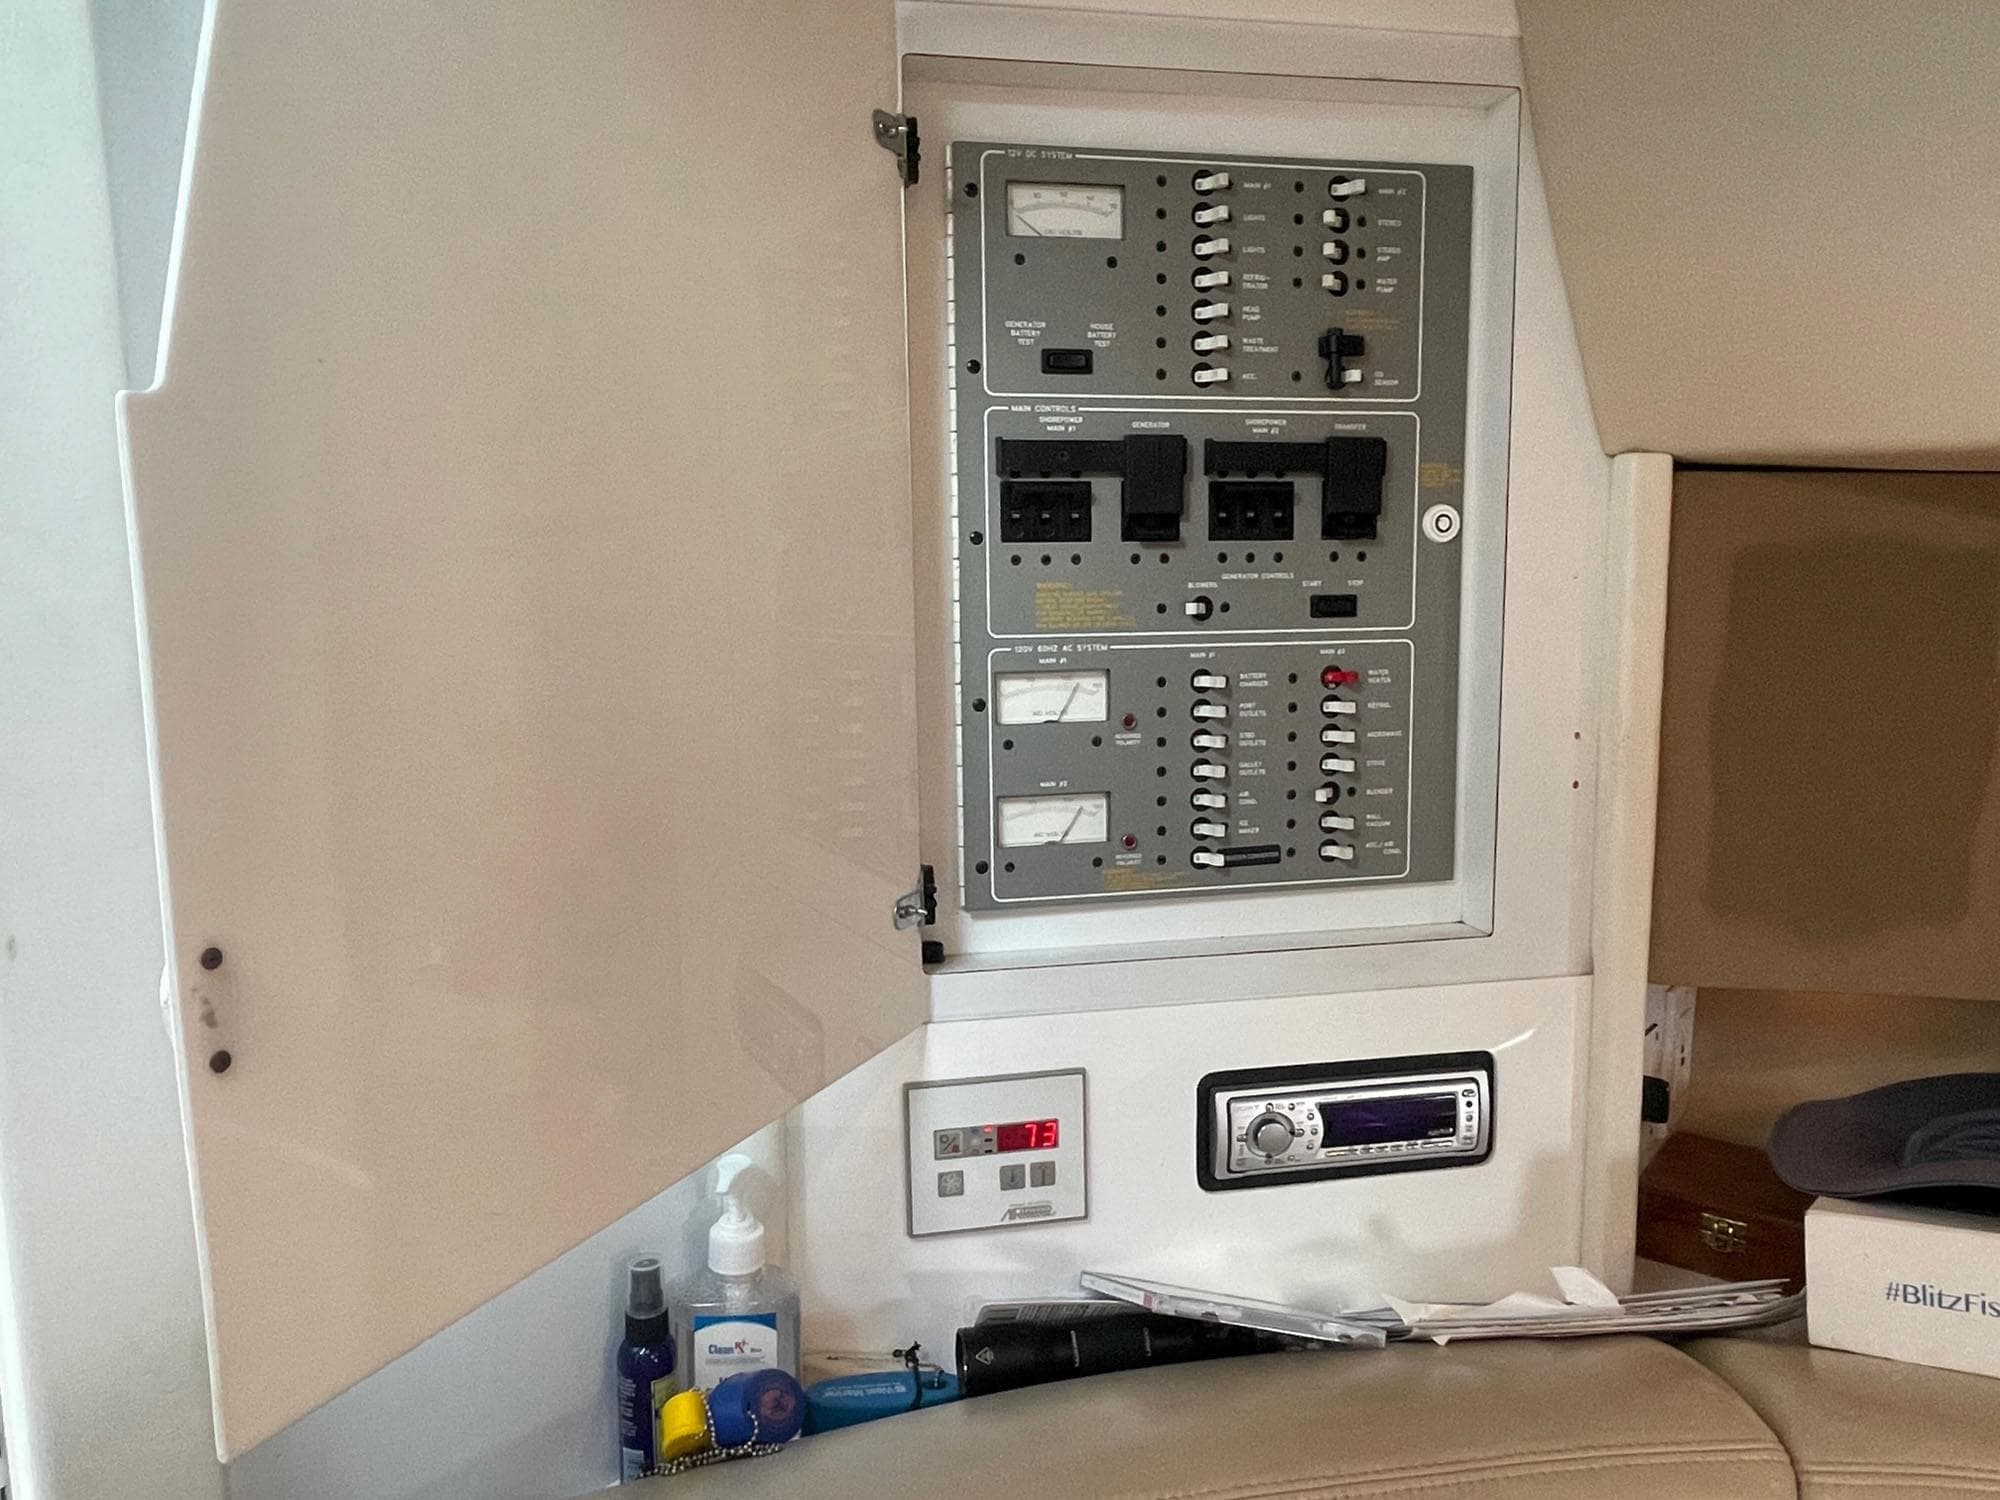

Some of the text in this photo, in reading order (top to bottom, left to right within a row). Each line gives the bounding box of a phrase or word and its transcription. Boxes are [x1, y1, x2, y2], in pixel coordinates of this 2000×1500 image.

[1041, 151, 1073, 159] SYSTEM
[1010, 329, 1040, 337] BATTERY
[1018, 338, 1034, 346] TEST
[1095, 339, 1110, 347] TEST
[1011, 404, 1076, 413] MAIN CONTROLS
[1014, 644, 1033, 653] 120V
[1062, 643, 1073, 651] AC
[1077, 642, 1108, 651] SYSTEM
[1025, 1122, 1057, 1148] 73
